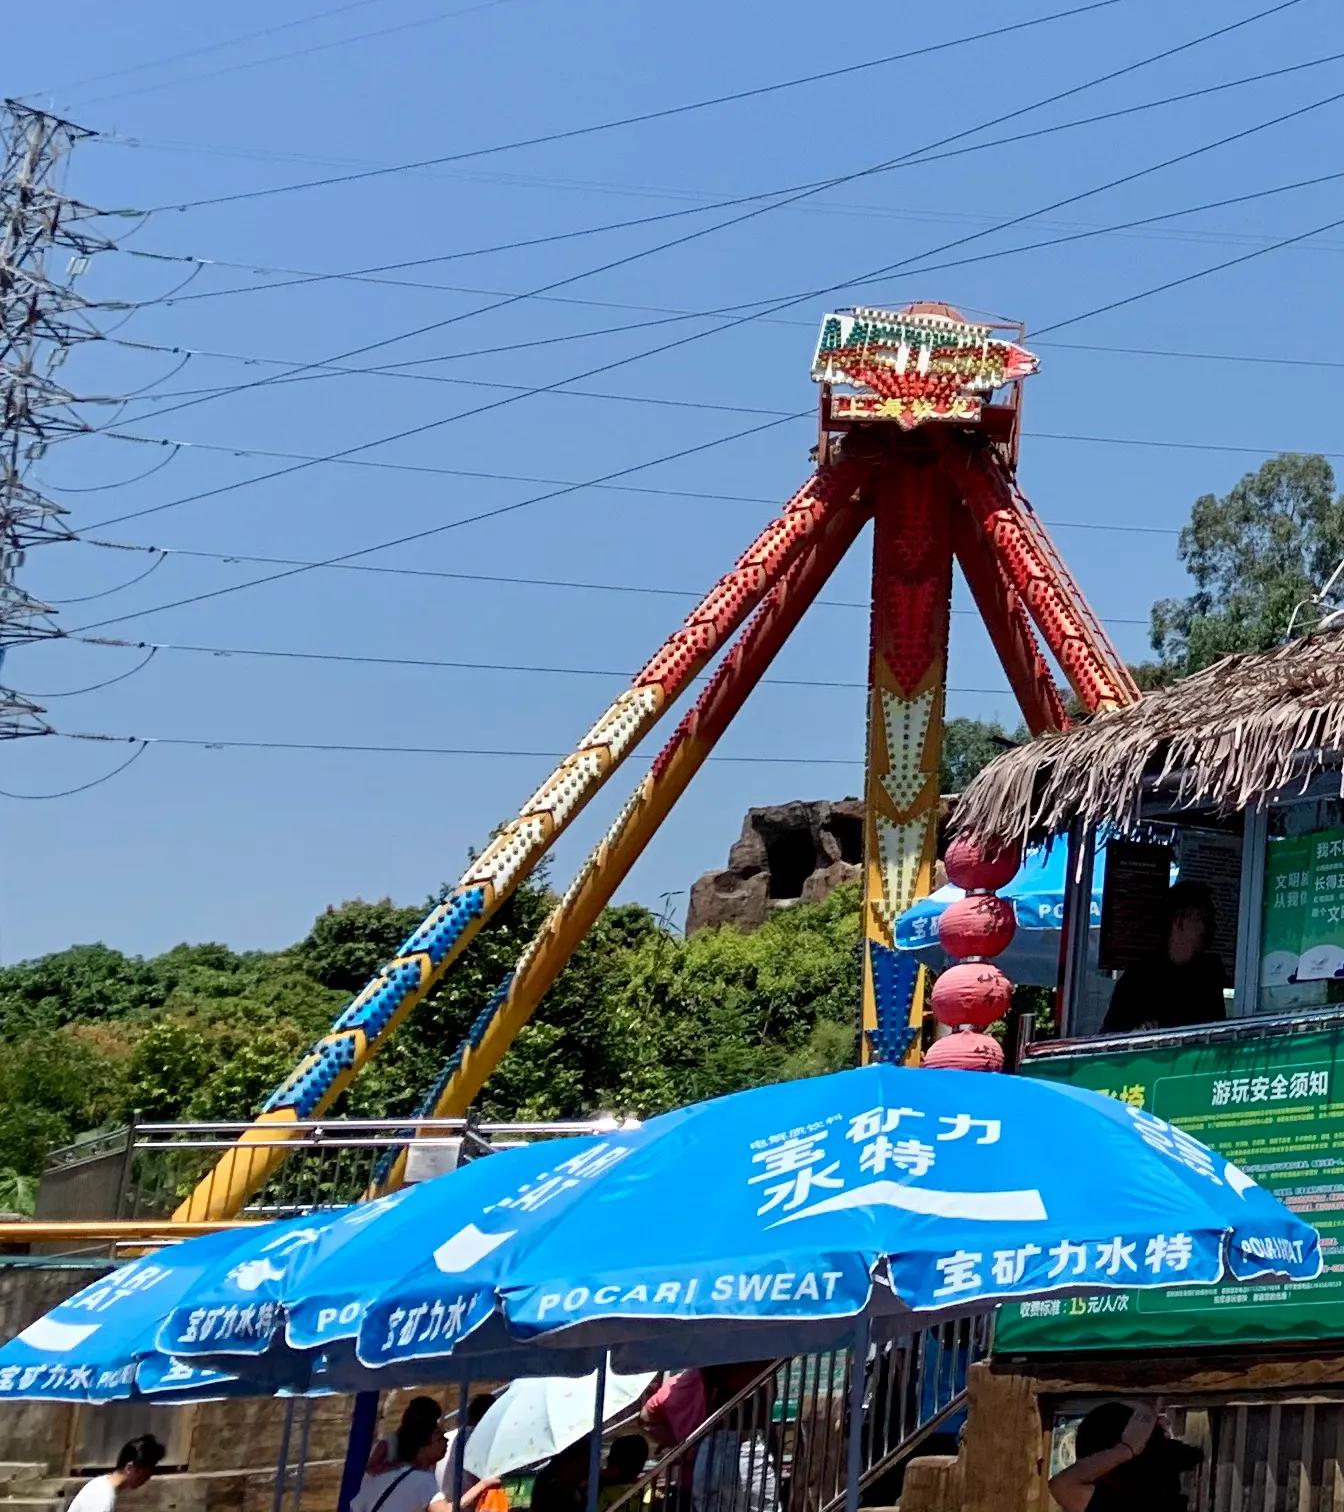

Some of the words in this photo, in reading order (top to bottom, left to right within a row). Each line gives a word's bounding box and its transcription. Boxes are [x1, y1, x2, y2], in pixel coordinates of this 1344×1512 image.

[1211, 1071, 1329, 1106] 游玩安全须知
[932, 1232, 1194, 1297] 宝矿力水特
[536, 1278, 698, 1321] POCARI
[710, 1271, 844, 1303] SWEAT
